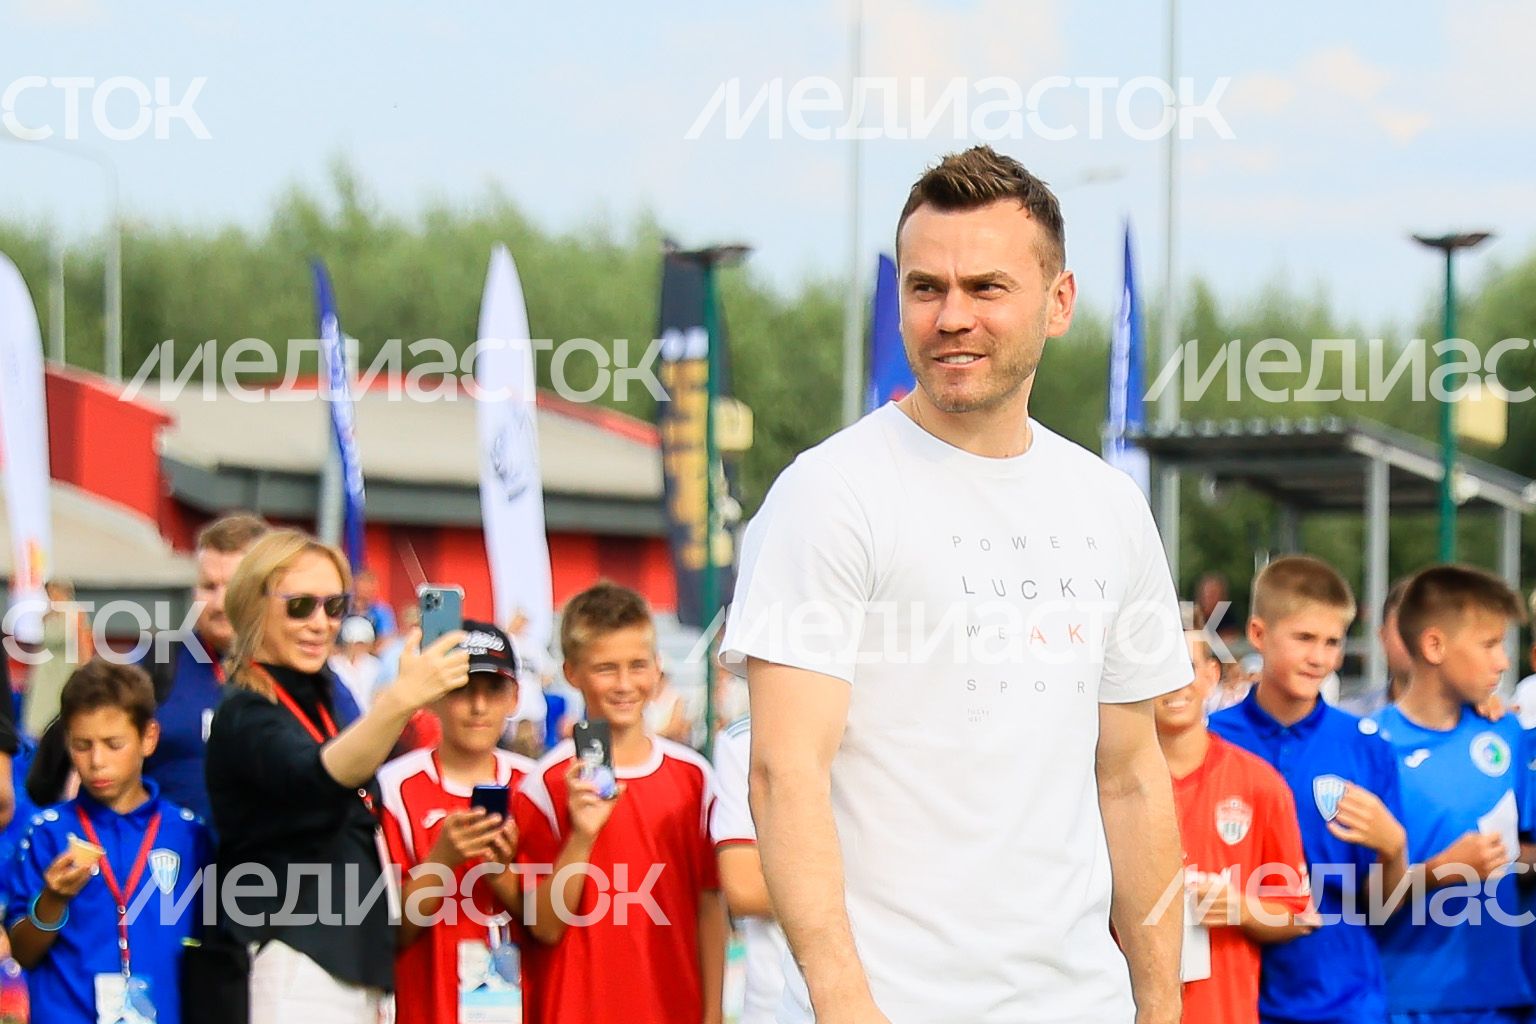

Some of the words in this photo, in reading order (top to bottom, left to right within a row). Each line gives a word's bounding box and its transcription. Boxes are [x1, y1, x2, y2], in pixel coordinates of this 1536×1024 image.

[952, 535, 1098, 551] POWER
[962, 576, 1107, 600] LUCKY
[966, 623, 1107, 648] WEAK
